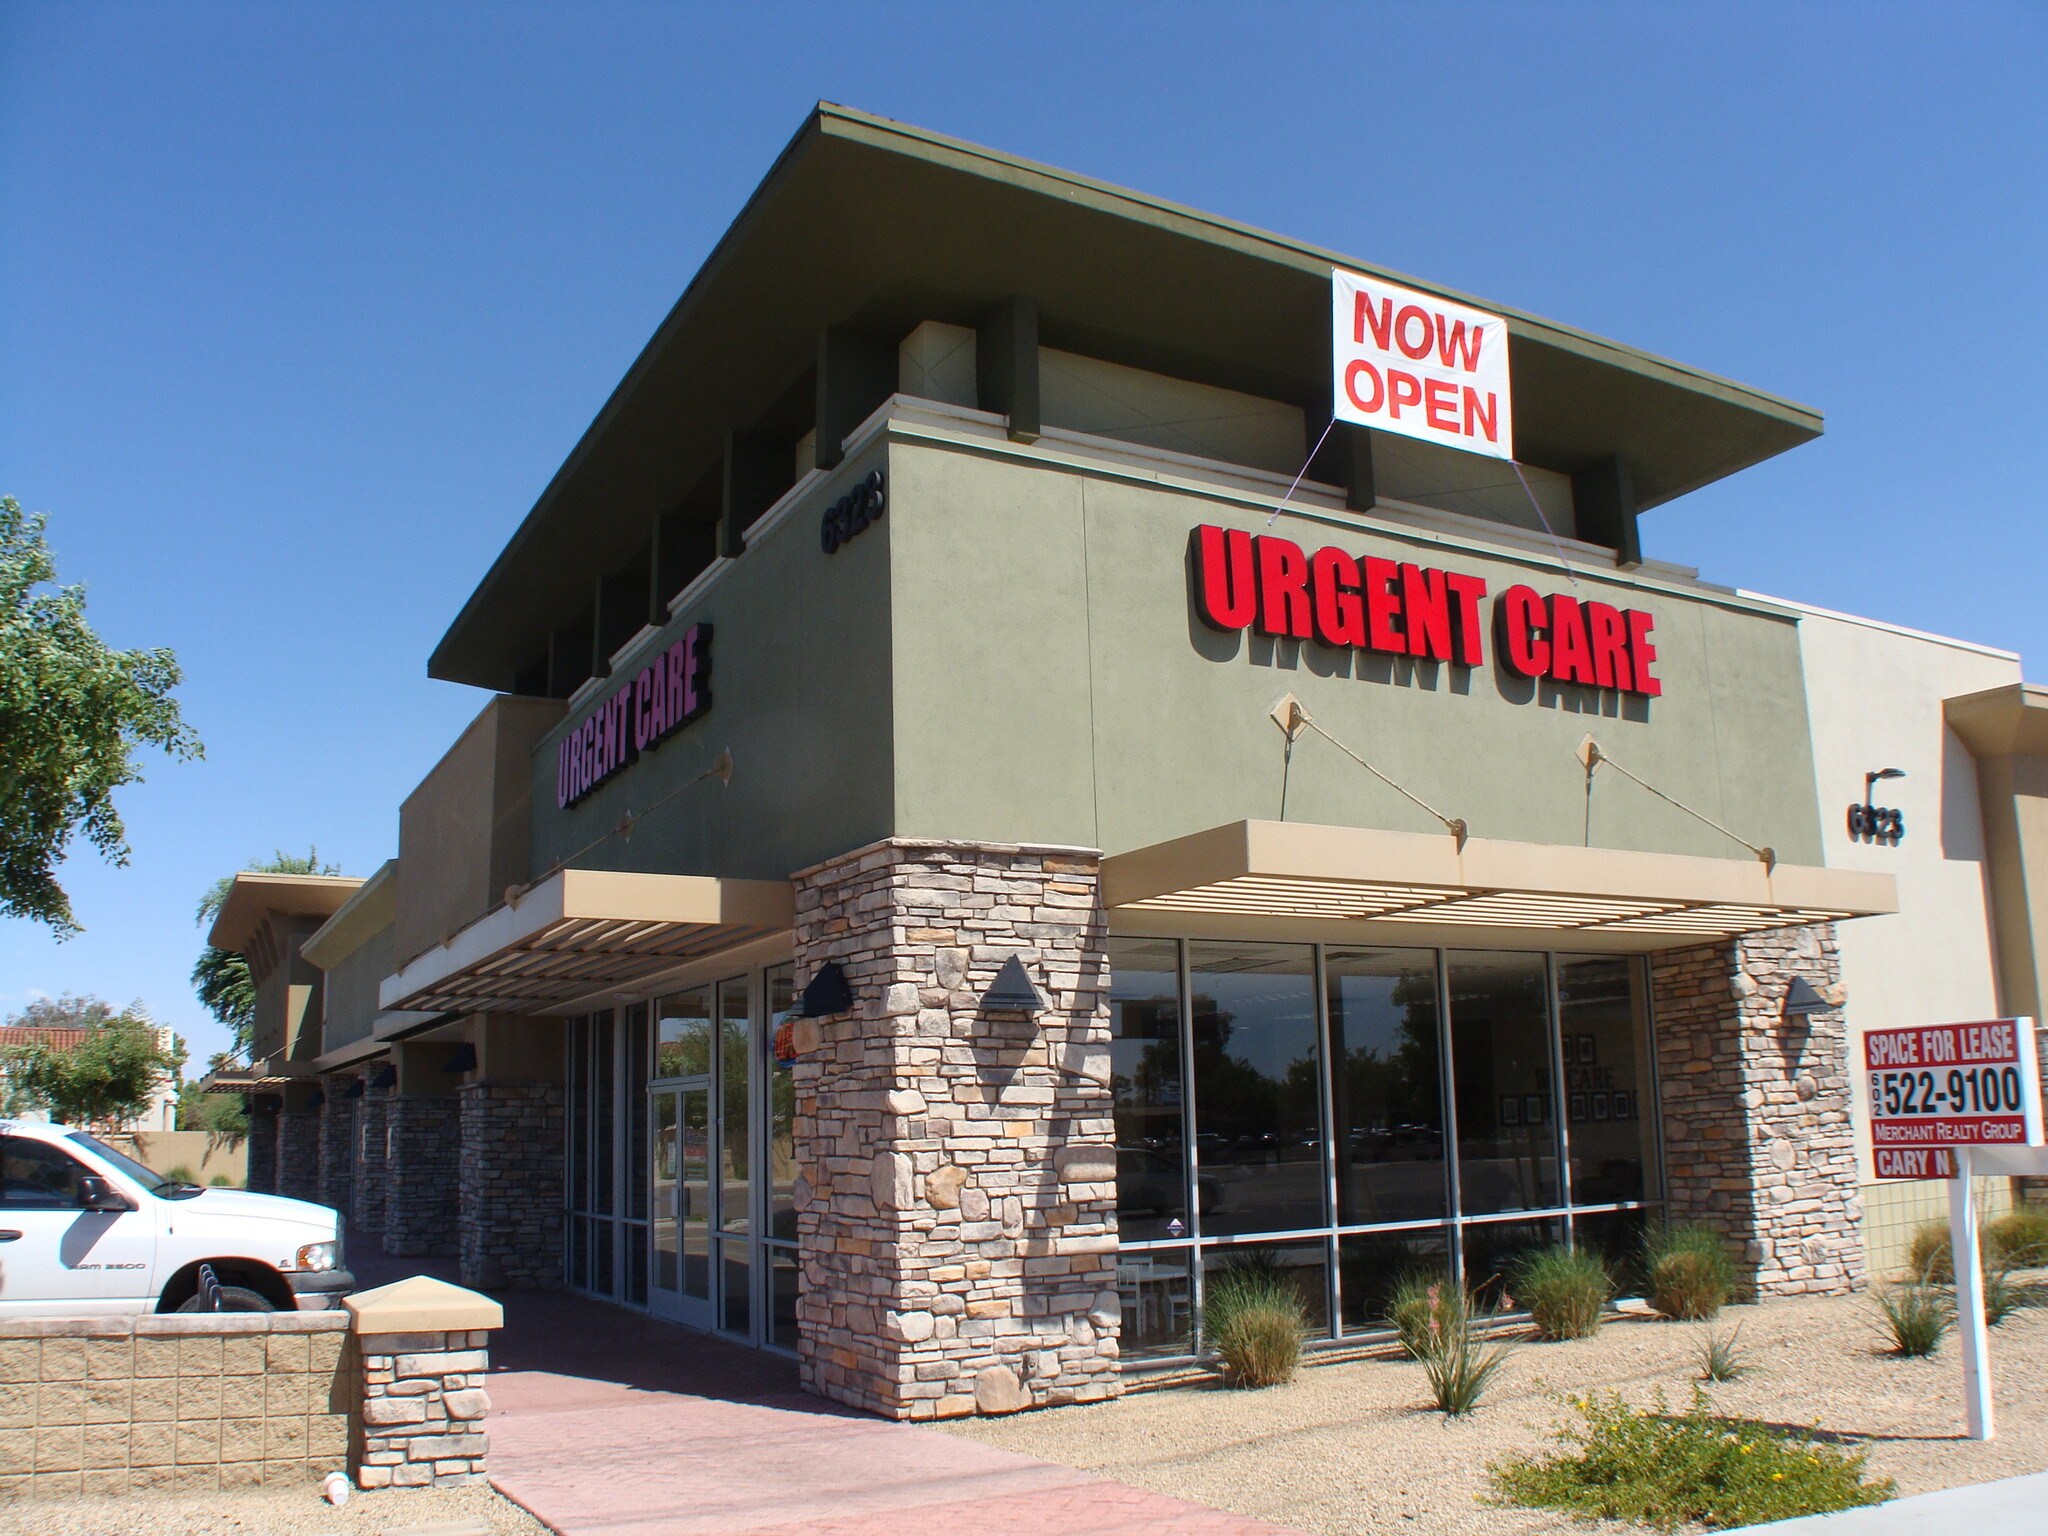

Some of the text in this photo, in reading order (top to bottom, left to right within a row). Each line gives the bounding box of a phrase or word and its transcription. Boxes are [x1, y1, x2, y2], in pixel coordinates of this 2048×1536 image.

[1353, 289, 1484, 373] NOW
[1344, 358, 1498, 443] OPEN
[1193, 523, 1662, 698] URGENT CARE
[558, 622, 708, 810] URGENT CARE
[1868, 1025, 2014, 1066] SPACE FOR LEASE
[1567, 1066, 1616, 1090] CARE
[1871, 1073, 1882, 1116] 602
[1883, 1066, 2021, 1115] 522-9100
[1875, 1120, 2022, 1141] MERCHANT REALTY GROUP
[1878, 1150, 1929, 1176] CARY
